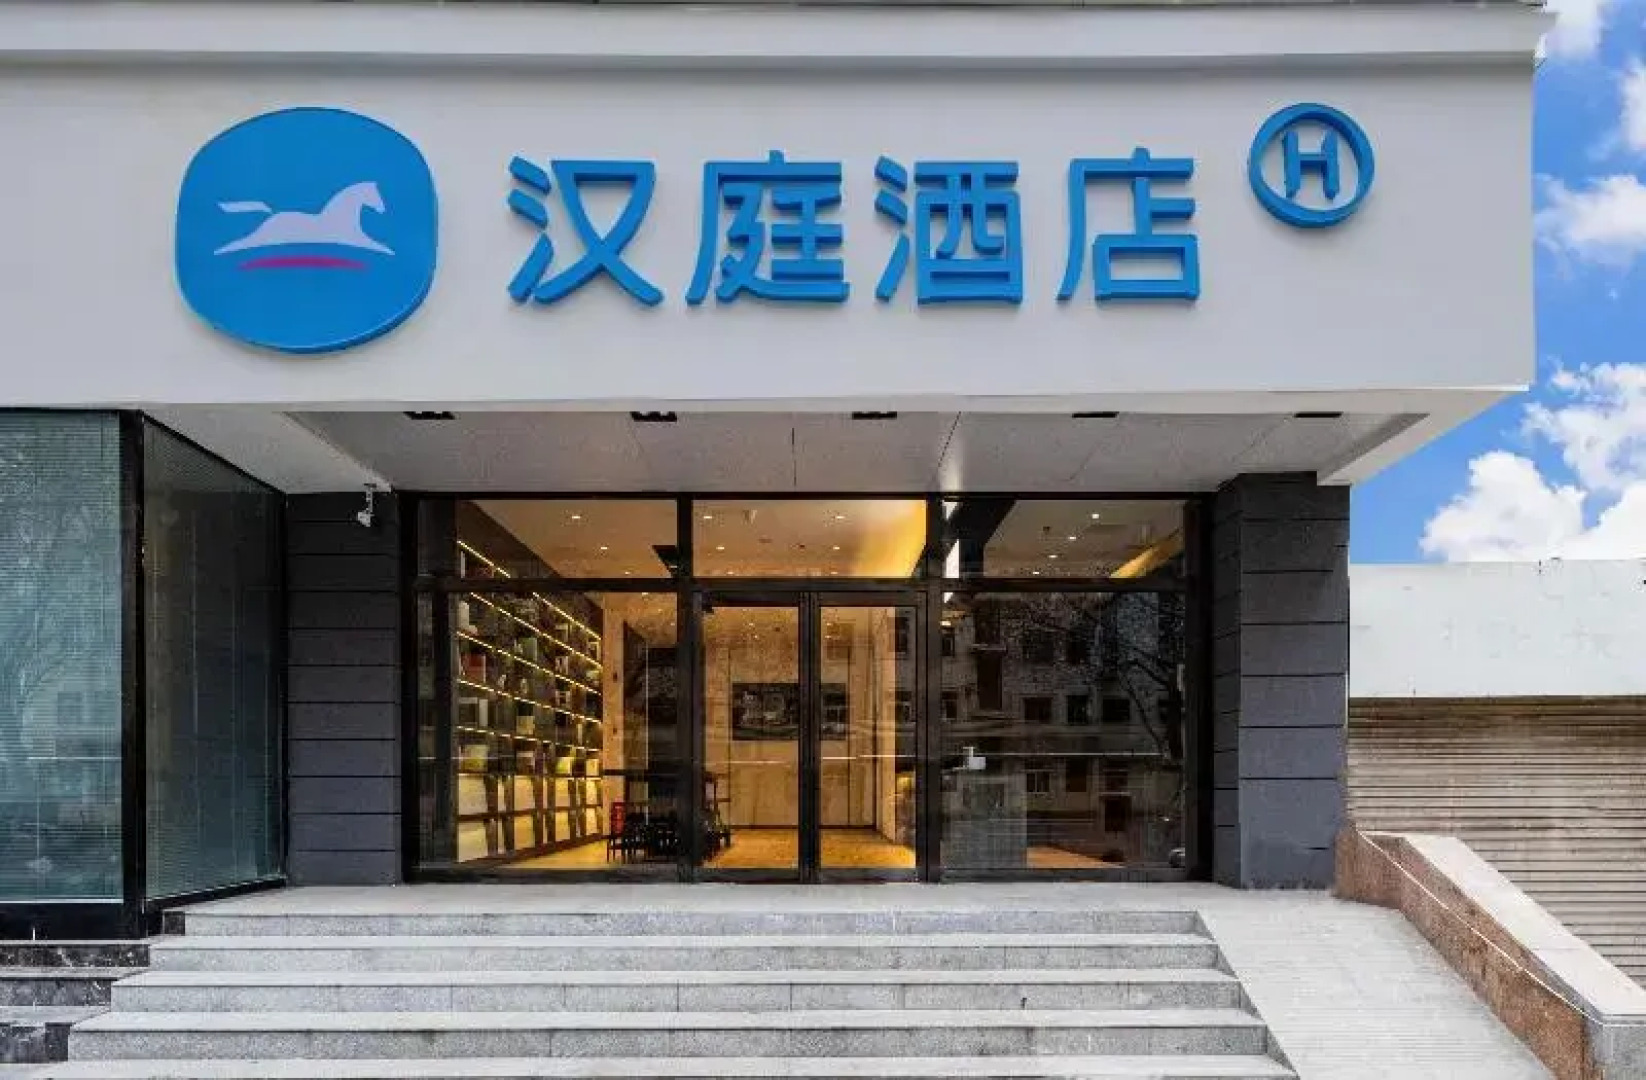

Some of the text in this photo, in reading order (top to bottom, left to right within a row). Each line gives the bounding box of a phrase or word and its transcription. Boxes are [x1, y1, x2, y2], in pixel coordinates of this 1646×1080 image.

[1281, 130, 1339, 200] H
[508, 148, 1200, 306] 汉庭酒店
